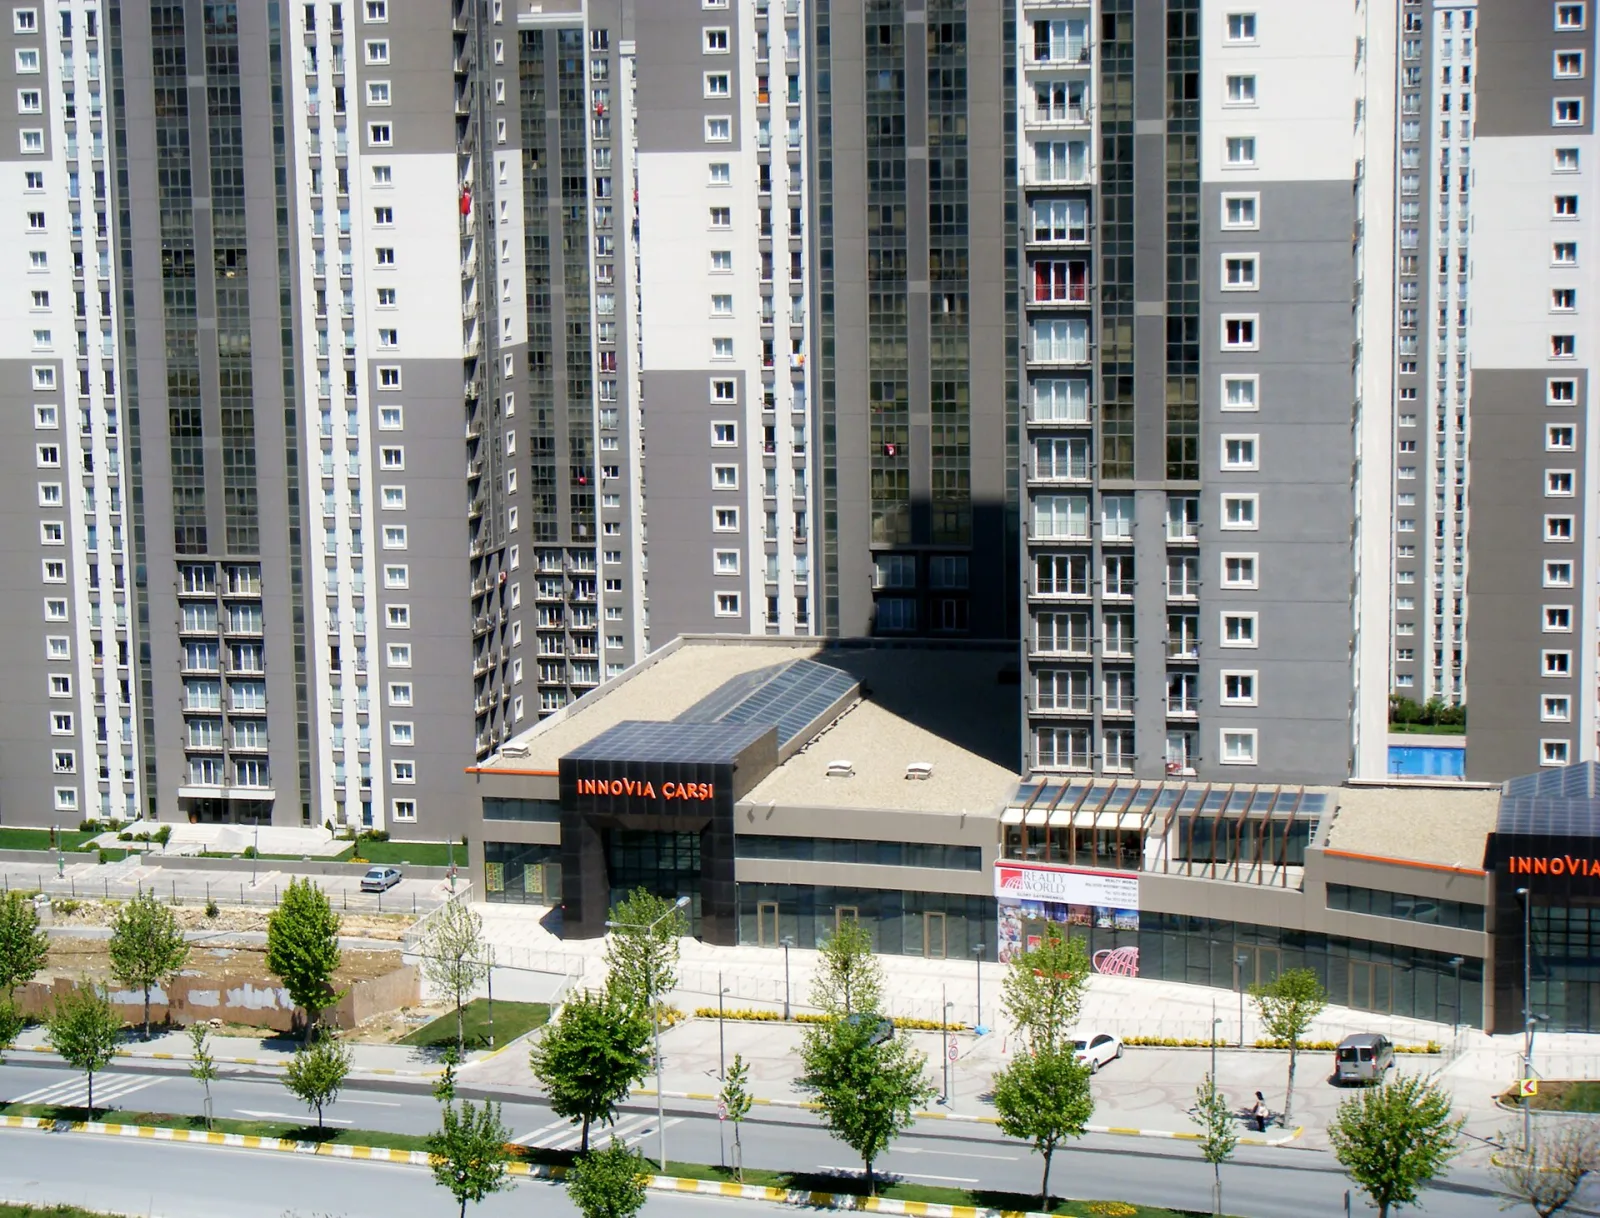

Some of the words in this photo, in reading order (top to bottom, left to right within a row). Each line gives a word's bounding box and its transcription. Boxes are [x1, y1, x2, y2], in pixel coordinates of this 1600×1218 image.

[577, 778, 656, 799] INNOVIA
[661, 781, 714, 800] ÇARŞI
[1509, 854, 1600, 878] INNOVIA
[1023, 870, 1066, 884] REALTY
[1023, 881, 1066, 894] WORLD
